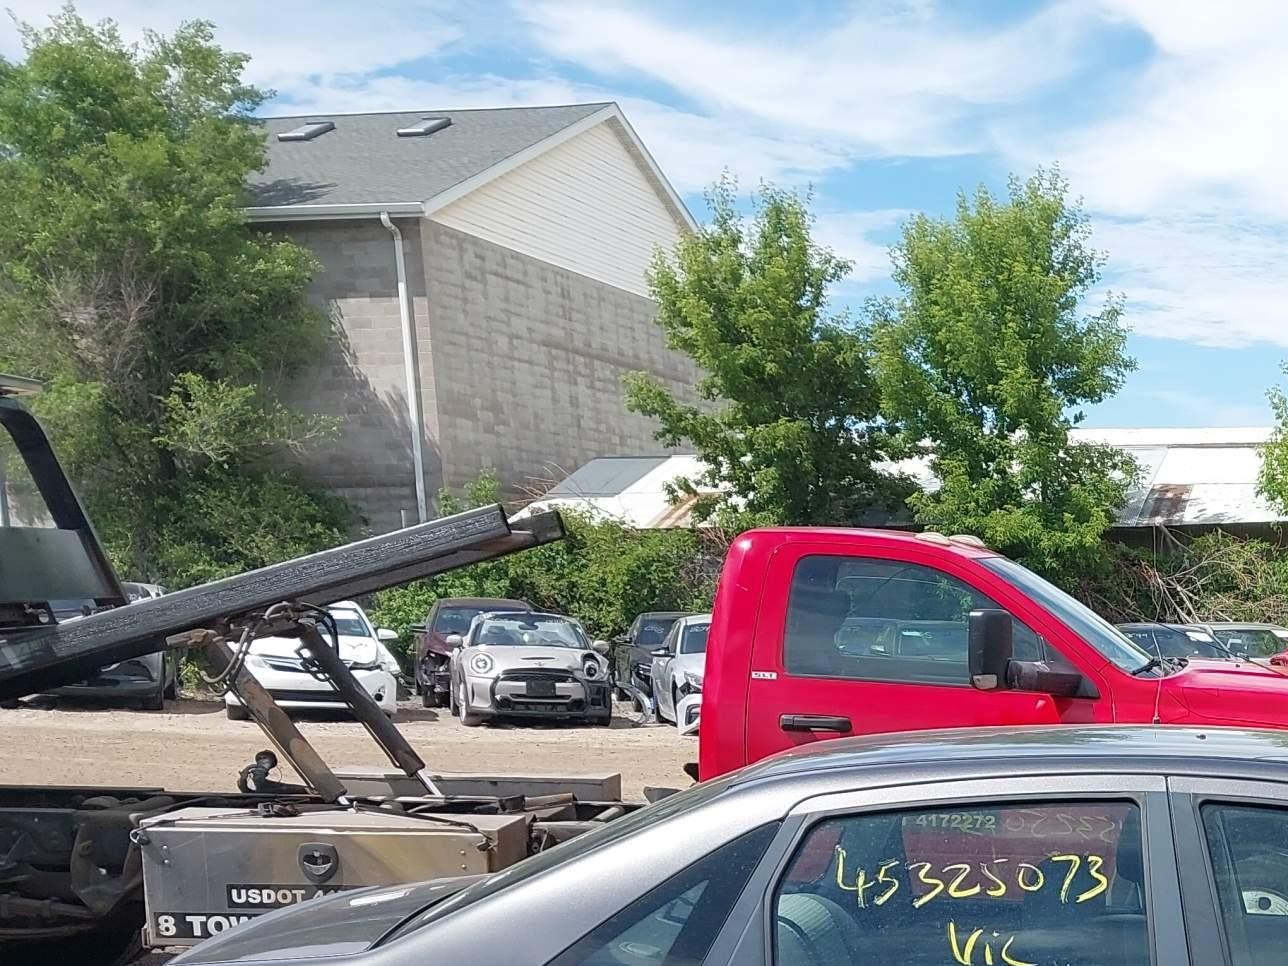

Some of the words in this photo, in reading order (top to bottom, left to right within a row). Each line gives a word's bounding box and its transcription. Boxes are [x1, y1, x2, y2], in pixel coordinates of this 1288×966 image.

[915, 814, 997, 829] 4172272
[834, 844, 1108, 909] 45325073
[231, 888, 306, 904] USDOT
[157, 915, 177, 937] 8
